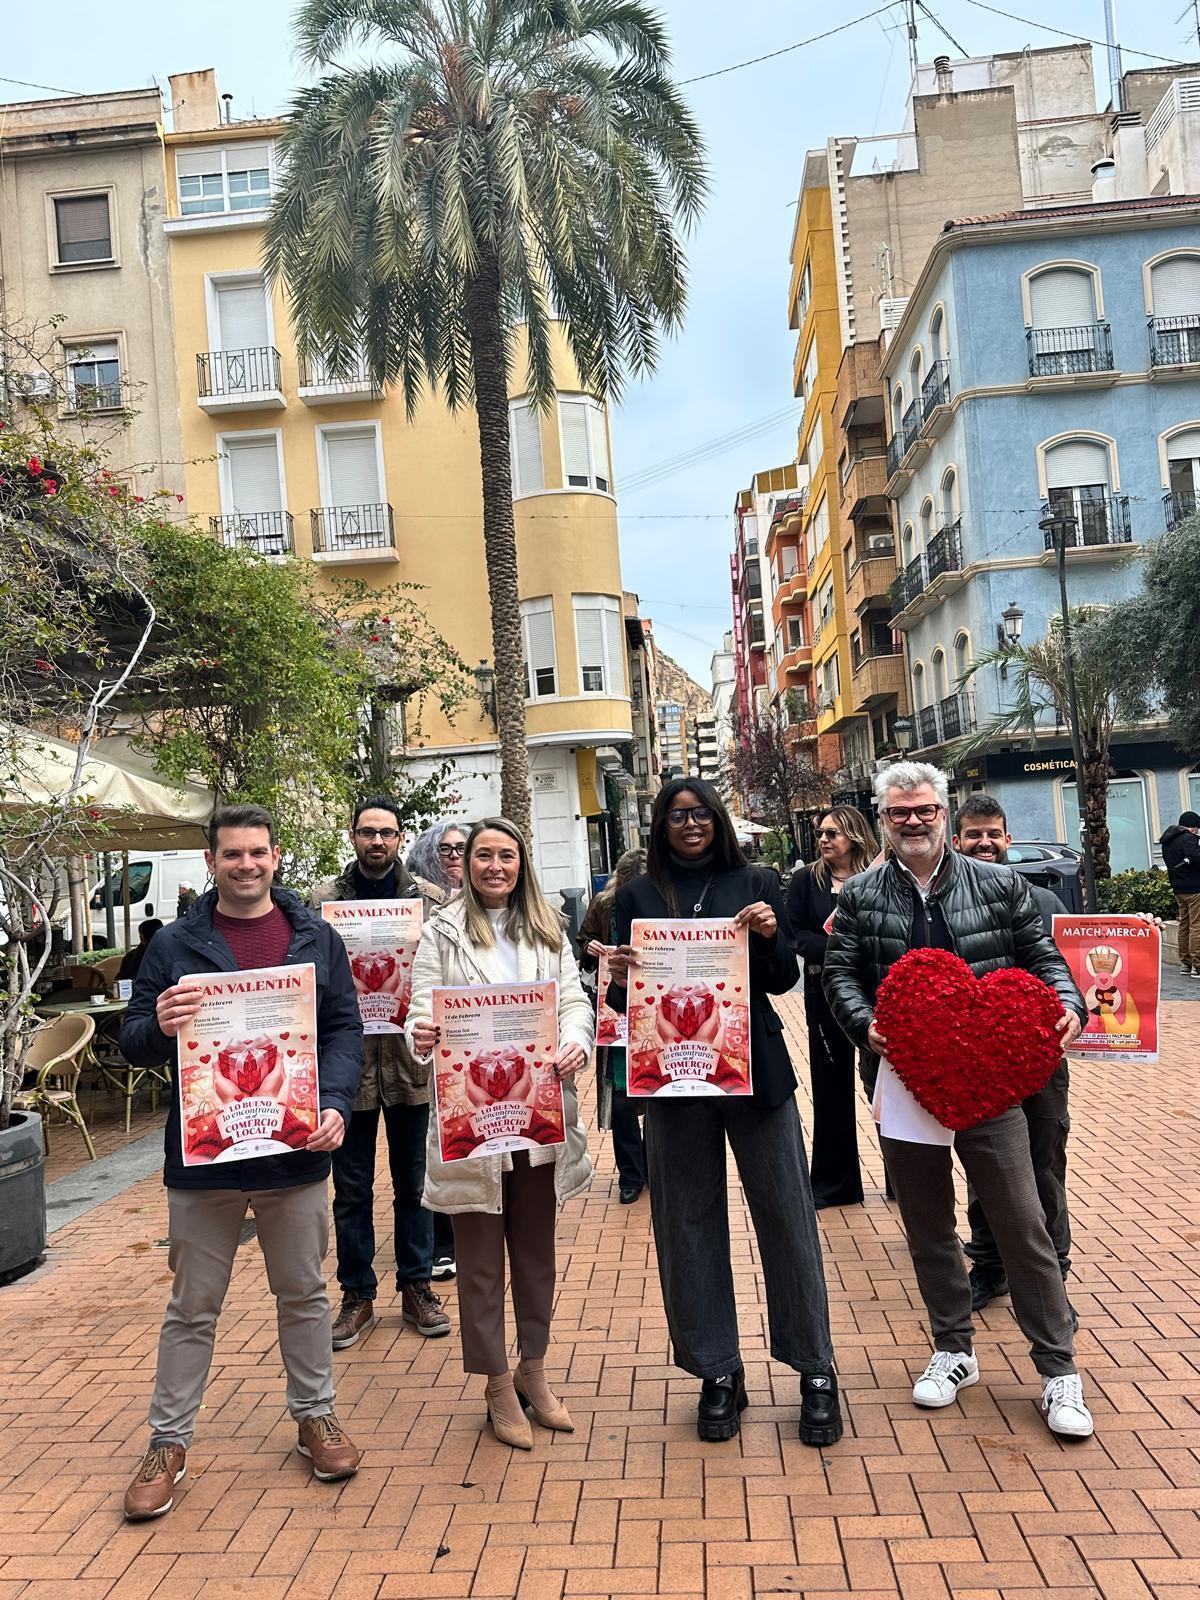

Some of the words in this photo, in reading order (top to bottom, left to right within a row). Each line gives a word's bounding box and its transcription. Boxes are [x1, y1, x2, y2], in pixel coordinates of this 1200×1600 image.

[334, 908, 355, 918] SAN
[358, 905, 412, 917] VALENTÍN
[643, 930, 667, 940] SAN
[670, 926, 736, 940] VALENTÍN
[1062, 928, 1100, 936] MATCH
[1106, 928, 1150, 937] MERCAT
[226, 974, 301, 994] VALENTÍN
[444, 998, 471, 1009] SAN
[474, 990, 544, 1006] VALENTÍN
[665, 1061, 712, 1070] COMERCIO
[229, 1104, 241, 1112] LO
[242, 1100, 272, 1108] BUENO
[225, 1118, 278, 1133] COMERCIO
[478, 1119, 526, 1132] COMERCIO
[488, 1126, 517, 1135] LOCAL
[236, 1127, 268, 1138] LOCAL
